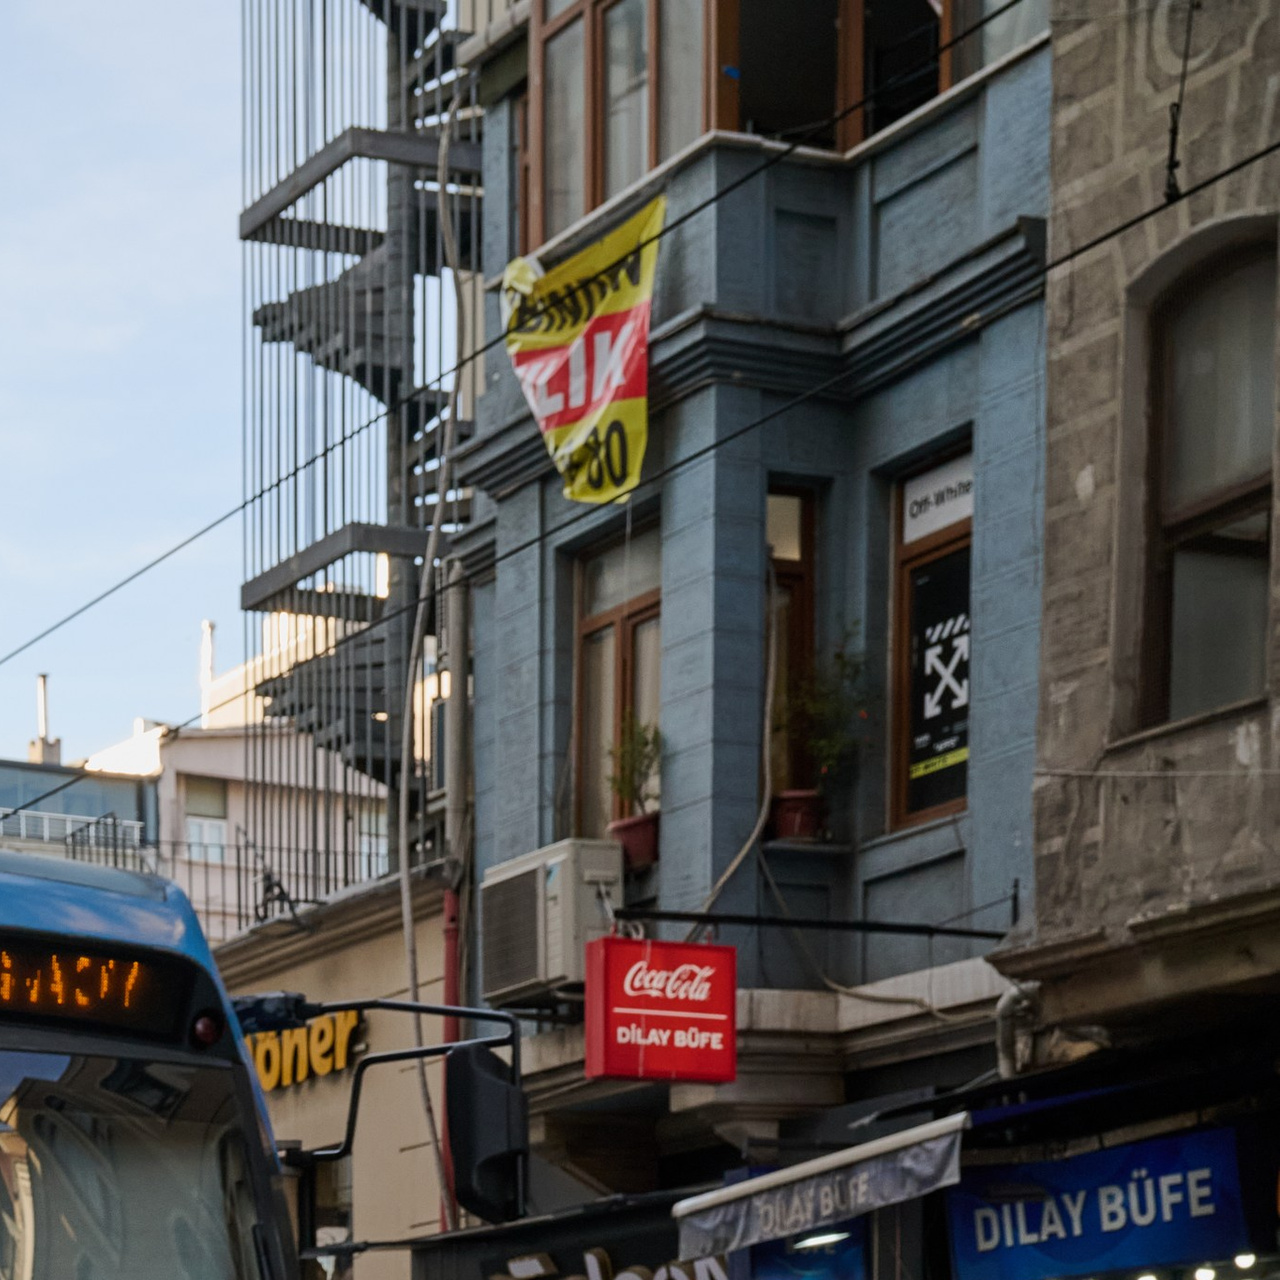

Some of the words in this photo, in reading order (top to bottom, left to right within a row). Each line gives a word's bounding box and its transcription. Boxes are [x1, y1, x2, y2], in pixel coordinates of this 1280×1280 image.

[623, 960, 716, 1001] Coca-Cola
[245, 1009, 358, 1092] öner
[616, 1022, 671, 1047] DİLAY
[673, 1026, 724, 1050] BÜFE
[1098, 1167, 1215, 1232] BÜFE
